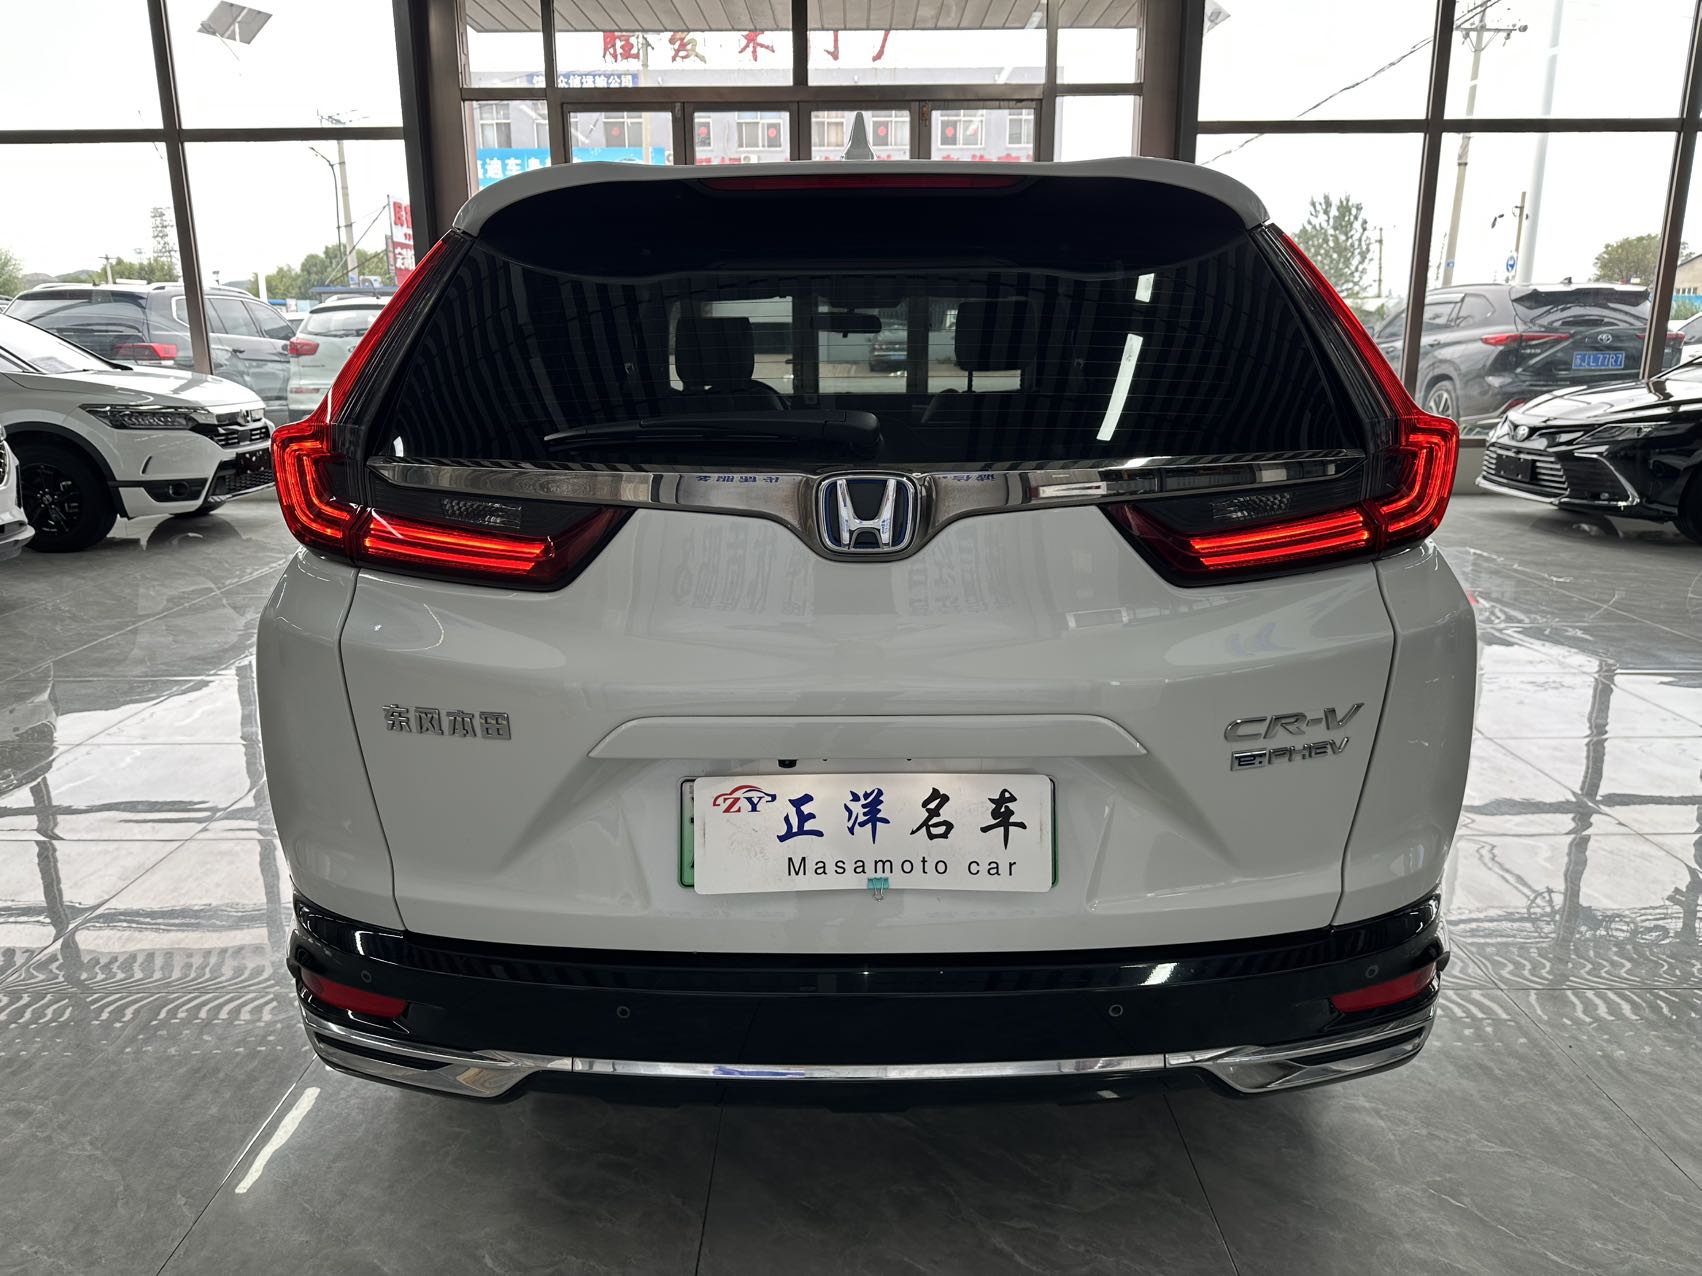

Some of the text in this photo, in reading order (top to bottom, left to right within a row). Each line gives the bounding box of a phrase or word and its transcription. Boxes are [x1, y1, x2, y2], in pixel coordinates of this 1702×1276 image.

[382, 703, 511, 740] 东风本田
[1224, 702, 1364, 742] CR-V
[722, 796, 765, 813] ZY
[776, 787, 1027, 850] 正洋名车
[787, 856, 1017, 876] Masamoto car
